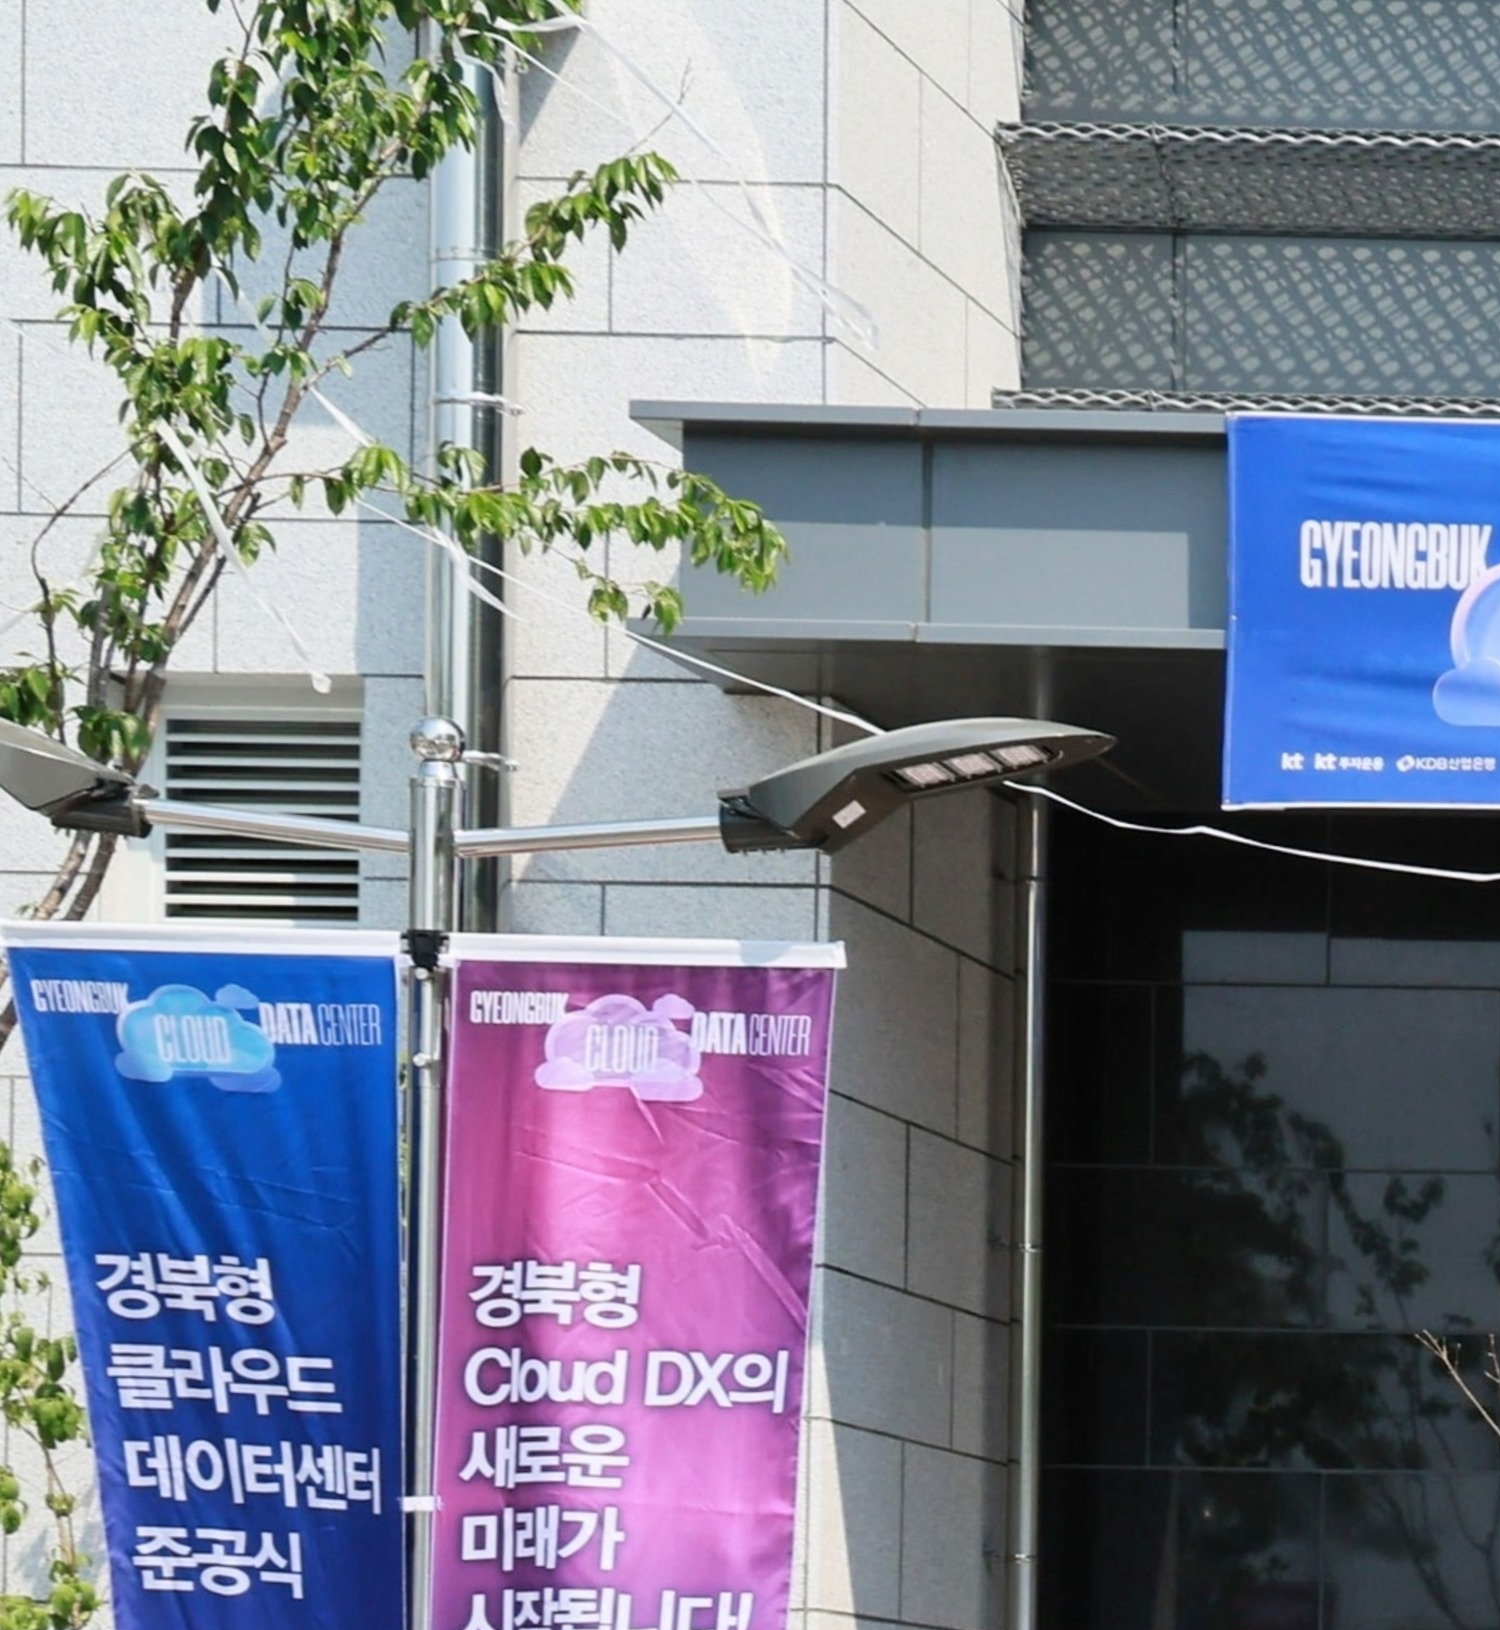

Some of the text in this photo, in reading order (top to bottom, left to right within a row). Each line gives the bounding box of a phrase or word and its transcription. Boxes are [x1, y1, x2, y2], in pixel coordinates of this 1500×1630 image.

[1299, 521, 1493, 591] GYEONGBUK
[31, 980, 381, 1066] GYEONGBUK CLOUD DATA CENTER
[470, 991, 811, 1075] GYEONGBUK CLOUD DATA CENTER
[96, 1253, 275, 1324] 경북형
[468, 1261, 640, 1330] 경북형
[107, 1344, 342, 1415] 클라우드
[463, 1350, 789, 1416] Cloud DX의
[123, 1435, 380, 1514] 데이터센터
[460, 1426, 630, 1490] 새로운
[133, 1527, 303, 1599] 준공식
[461, 1508, 624, 1573] 미래가
